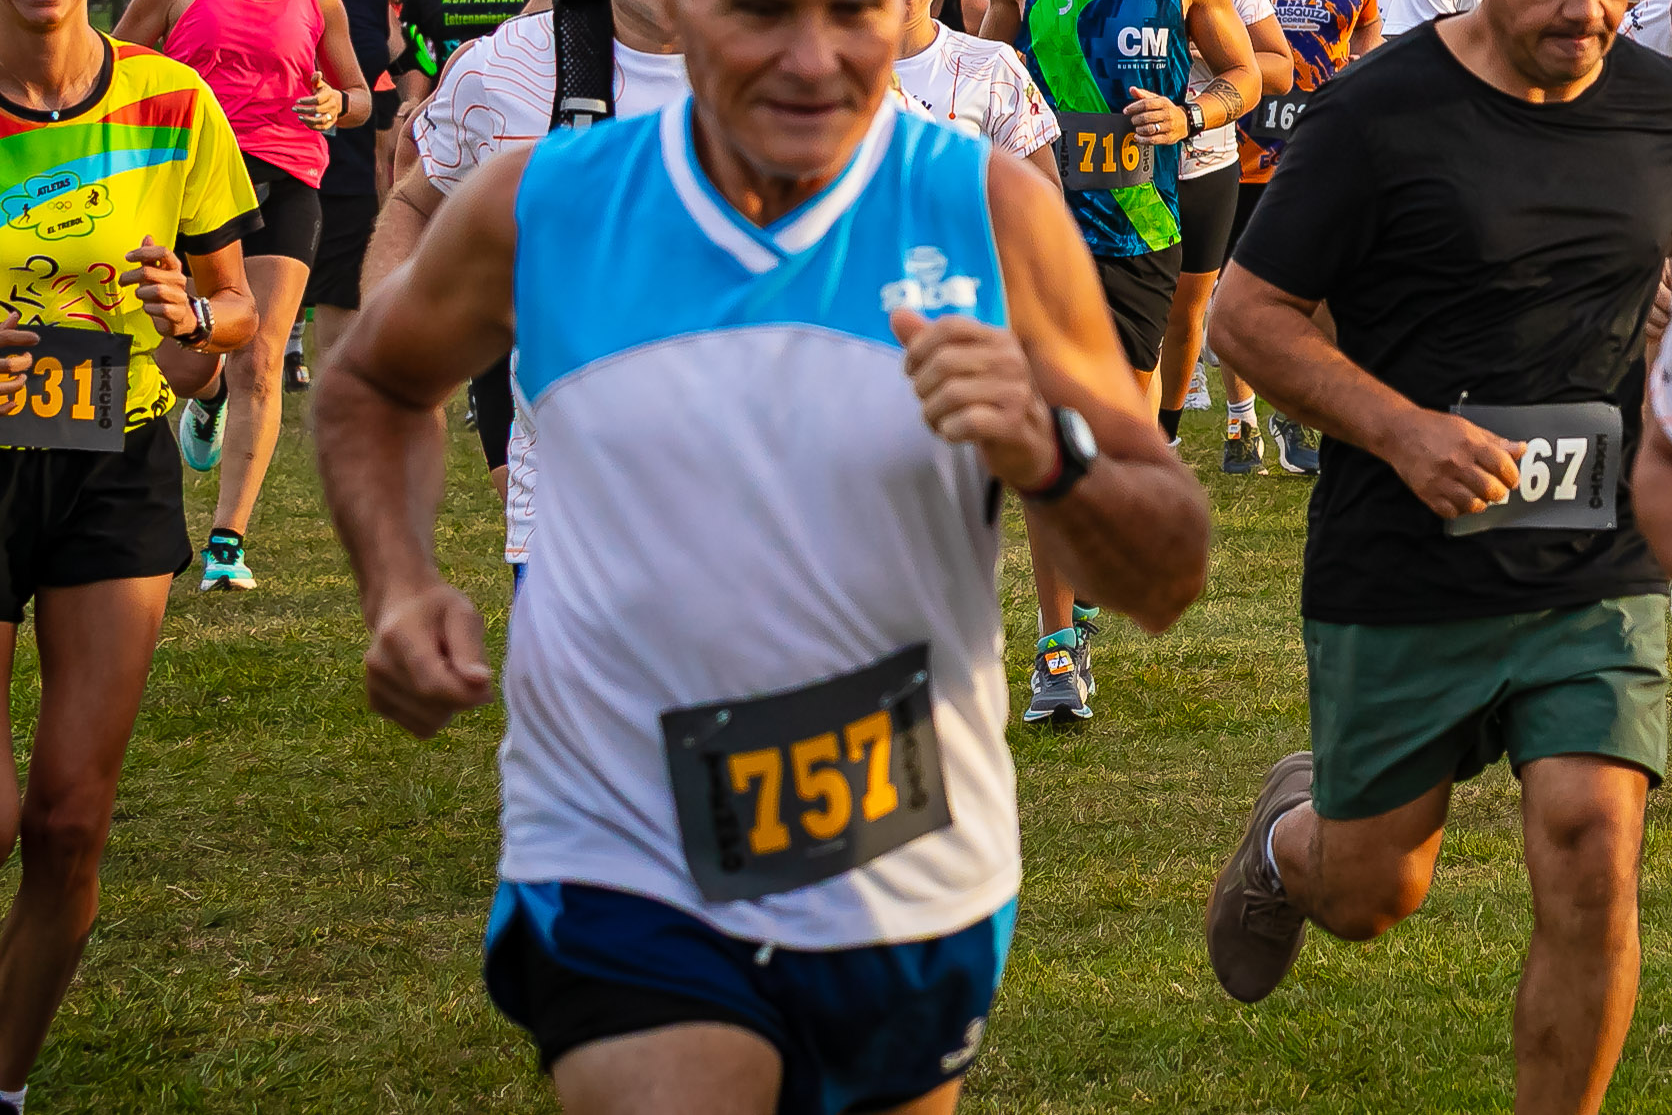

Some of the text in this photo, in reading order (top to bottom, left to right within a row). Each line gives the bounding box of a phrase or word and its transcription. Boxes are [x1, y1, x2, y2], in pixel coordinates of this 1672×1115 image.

[1117, 26, 1169, 57] CM
[1265, 100, 1307, 130] 16
[1077, 132, 1140, 172] 716
[37, 178, 71, 198] ATLETAS
[47, 216, 84, 235] EL TREBOL
[99, 356, 112, 430] EXACTO
[1488, 437, 1588, 506] 67
[728, 709, 899, 856] 757
